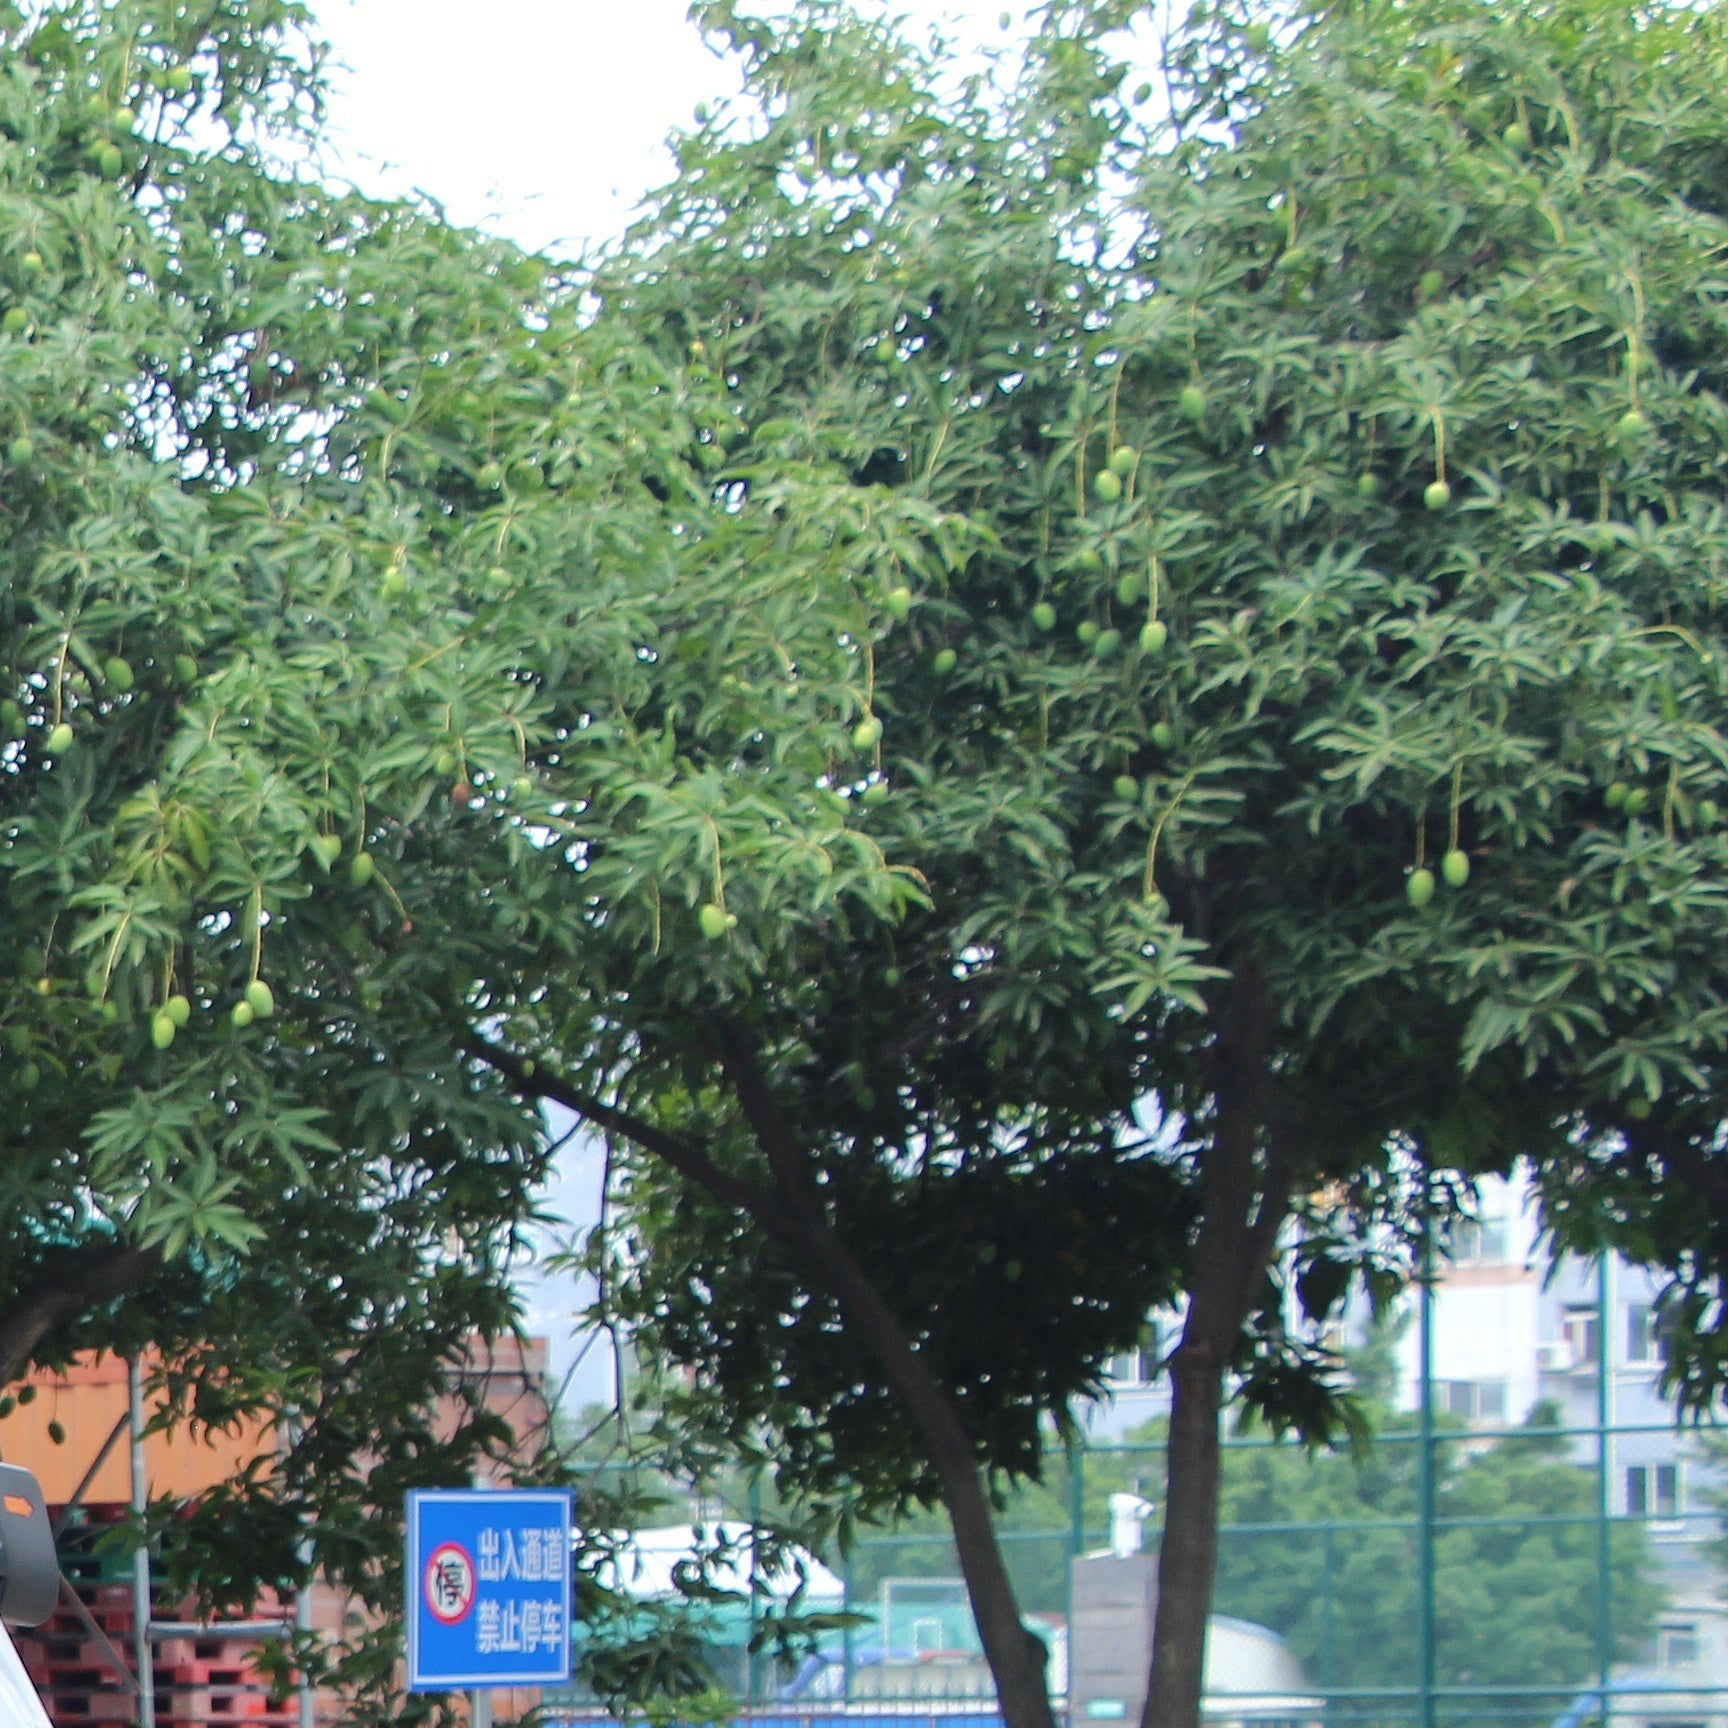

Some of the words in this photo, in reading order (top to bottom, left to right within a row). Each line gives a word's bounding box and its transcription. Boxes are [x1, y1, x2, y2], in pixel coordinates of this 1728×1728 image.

[479, 1528, 563, 1581] 出入通道
[437, 1561, 464, 1606] 停
[478, 1600, 563, 1653] 禁止停车
